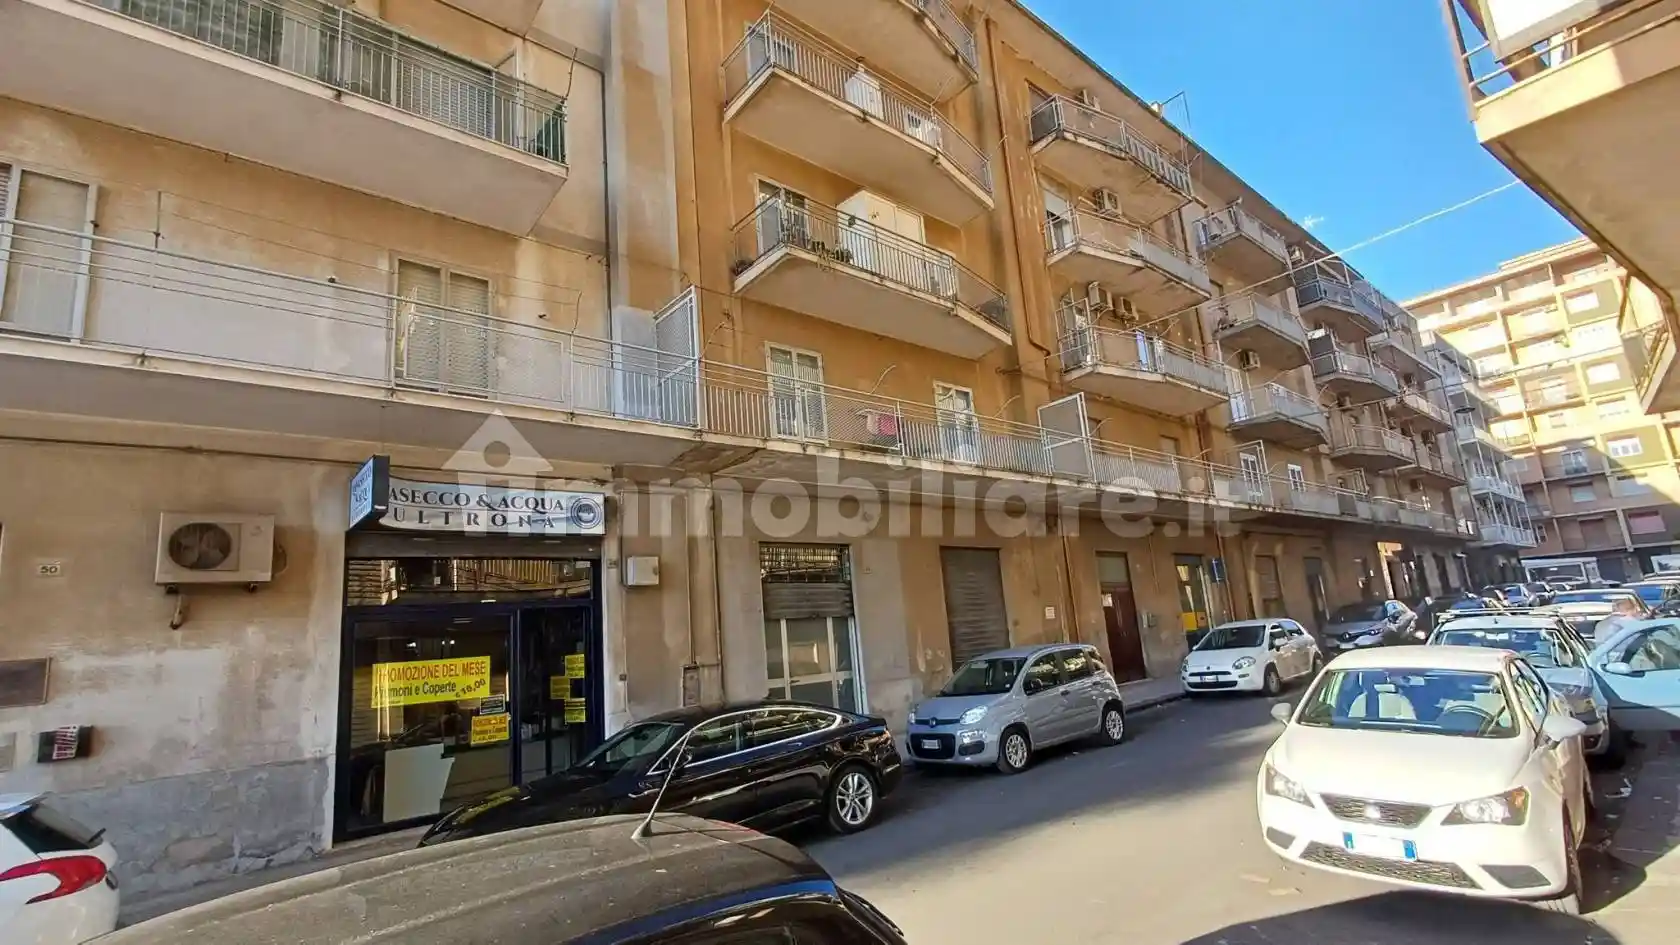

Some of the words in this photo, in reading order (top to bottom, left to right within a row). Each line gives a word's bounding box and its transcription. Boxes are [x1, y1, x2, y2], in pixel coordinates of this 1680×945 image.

[498, 495, 564, 514] ACQUA
[442, 663, 459, 677] DEL
[462, 661, 486, 676] MESE
[422, 681, 457, 697] Coperte
